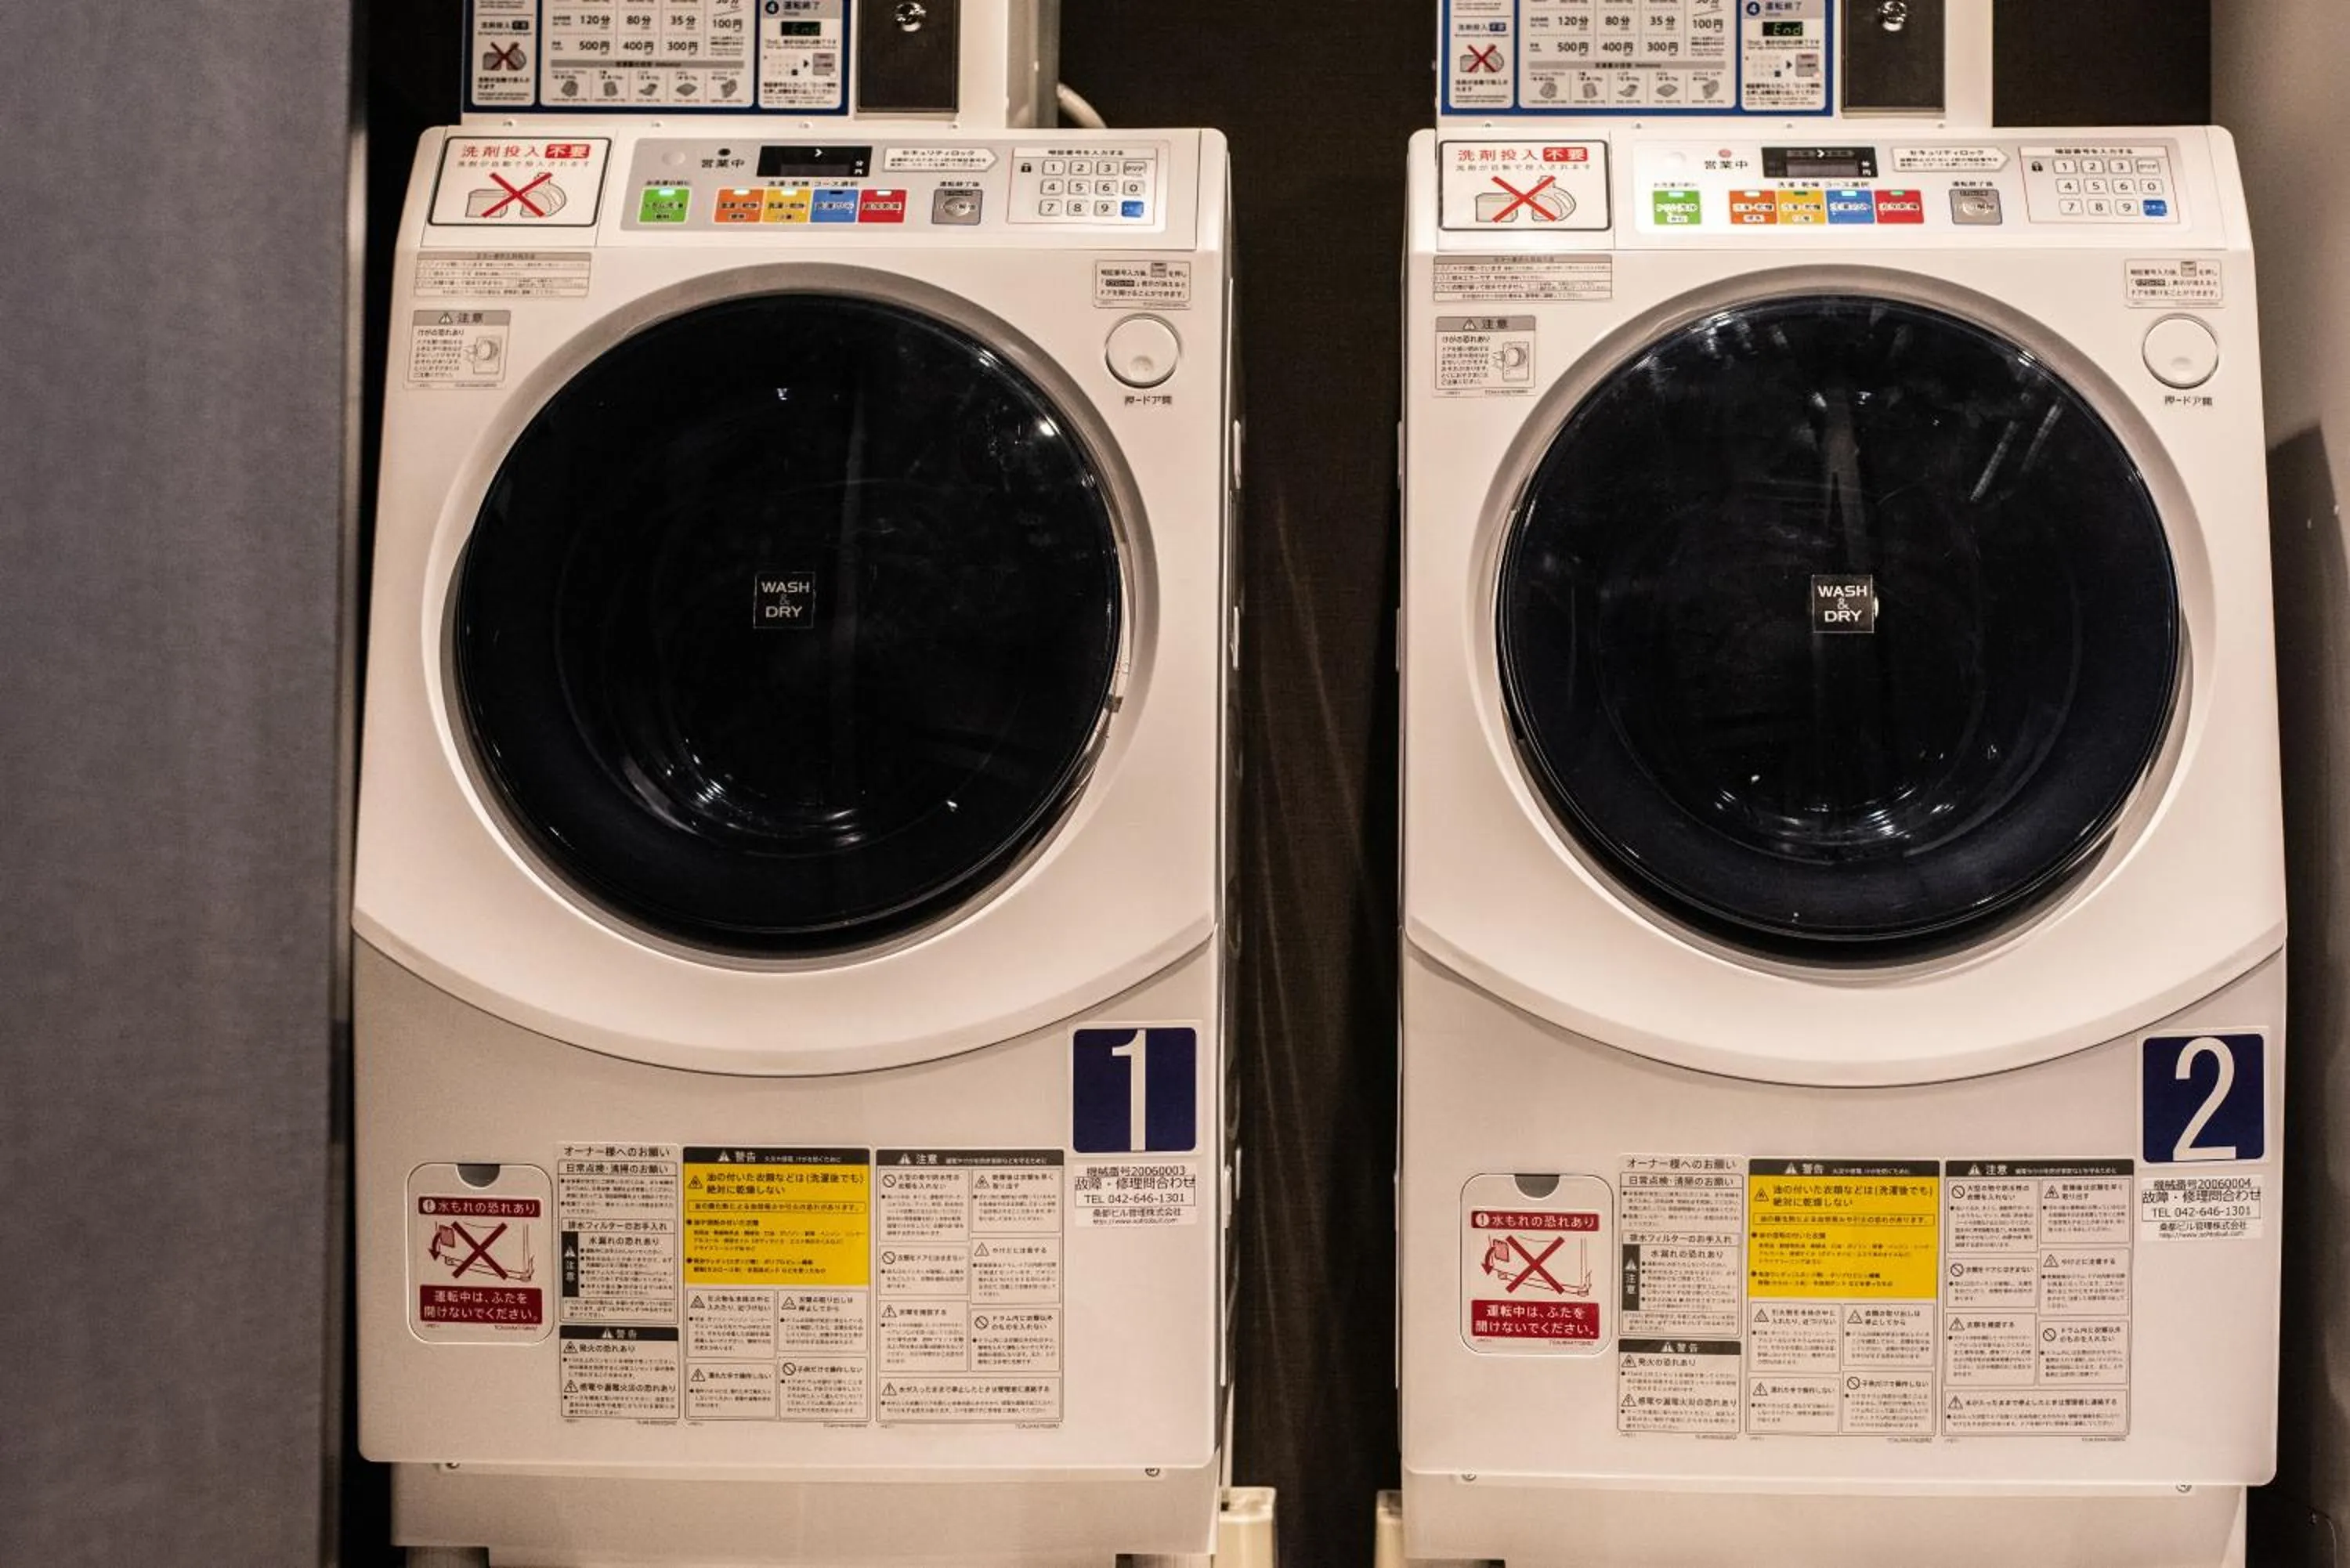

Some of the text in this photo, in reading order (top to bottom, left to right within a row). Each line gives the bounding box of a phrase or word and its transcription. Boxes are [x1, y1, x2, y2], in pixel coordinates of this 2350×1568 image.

[1558, 16, 1589, 27] 120分
[1605, 16, 1630, 26] 80分
[1650, 16, 1676, 27] 35分
[1692, 19, 1723, 29] 100円
[1773, 23, 1802, 35] End
[1557, 42, 1589, 52] 500円
[1602, 42, 1634, 52] 400円
[1647, 42, 1679, 52] 300円
[462, 145, 540, 157] 洗剤投入
[1458, 148, 1586, 162] 洗剤投入 不要
[1074, 204, 1081, 212] 8
[1101, 204, 1108, 212] 9
[2095, 203, 2102, 211] 8
[2123, 203, 2131, 211] 9
[761, 581, 809, 593] WASH
[1817, 585, 1867, 598] WASH
[779, 594, 790, 605] &
[1837, 597, 1849, 609] &
[765, 605, 802, 618] DRY
[1824, 610, 1862, 622] DRY
[1112, 1028, 1146, 1153] 1
[2172, 1036, 2236, 1162] 2
[564, 1146, 671, 1158] オーナー様へのお願い
[566, 1163, 668, 1174] 日常点検・清掃のお願い
[1628, 1158, 1737, 1170] オーナー様へのお願い
[1075, 1176, 1196, 1190] 故障・修理問合わせ
[1629, 1176, 1734, 1187] 日常点検・清掃のお願い
[707, 1186, 786, 1194] 絶対に乾燥しない
[1084, 1194, 1184, 1204] TEL 042-646-1301
[1773, 1198, 1853, 1207] 絶対に乾燥しない
[2142, 1190, 2261, 1204] 故障・修理問合わせ
[438, 1202, 536, 1214] 水もれの恐れあり
[2152, 1206, 2251, 1218] TEL 042-646-1301
[1491, 1216, 1595, 1228] 水もれの恐れあり
[434, 1290, 527, 1302] 運転中は、ふたを
[424, 1306, 538, 1321] 開けないでください。
[1487, 1304, 1585, 1318] 運転中は、ふたを
[1475, 1320, 1594, 1335] 開けないでください。
